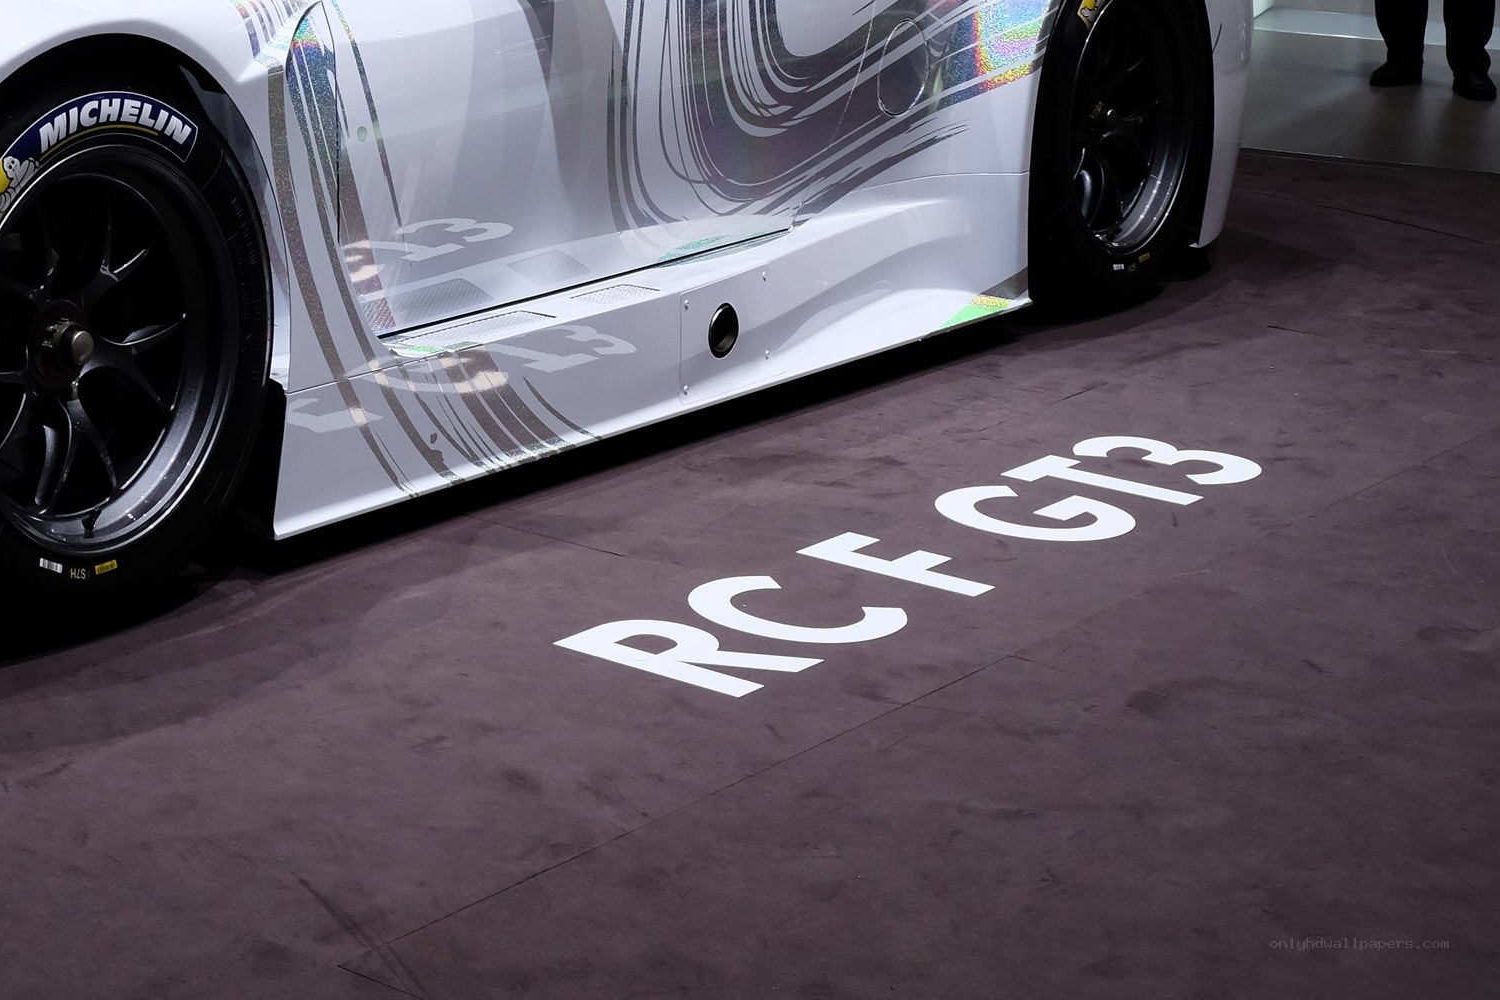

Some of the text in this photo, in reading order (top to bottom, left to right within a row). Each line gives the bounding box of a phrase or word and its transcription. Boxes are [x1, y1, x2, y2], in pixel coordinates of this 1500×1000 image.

[39, 97, 192, 153] MICHELIN
[552, 435, 1262, 698] RC F GT3
